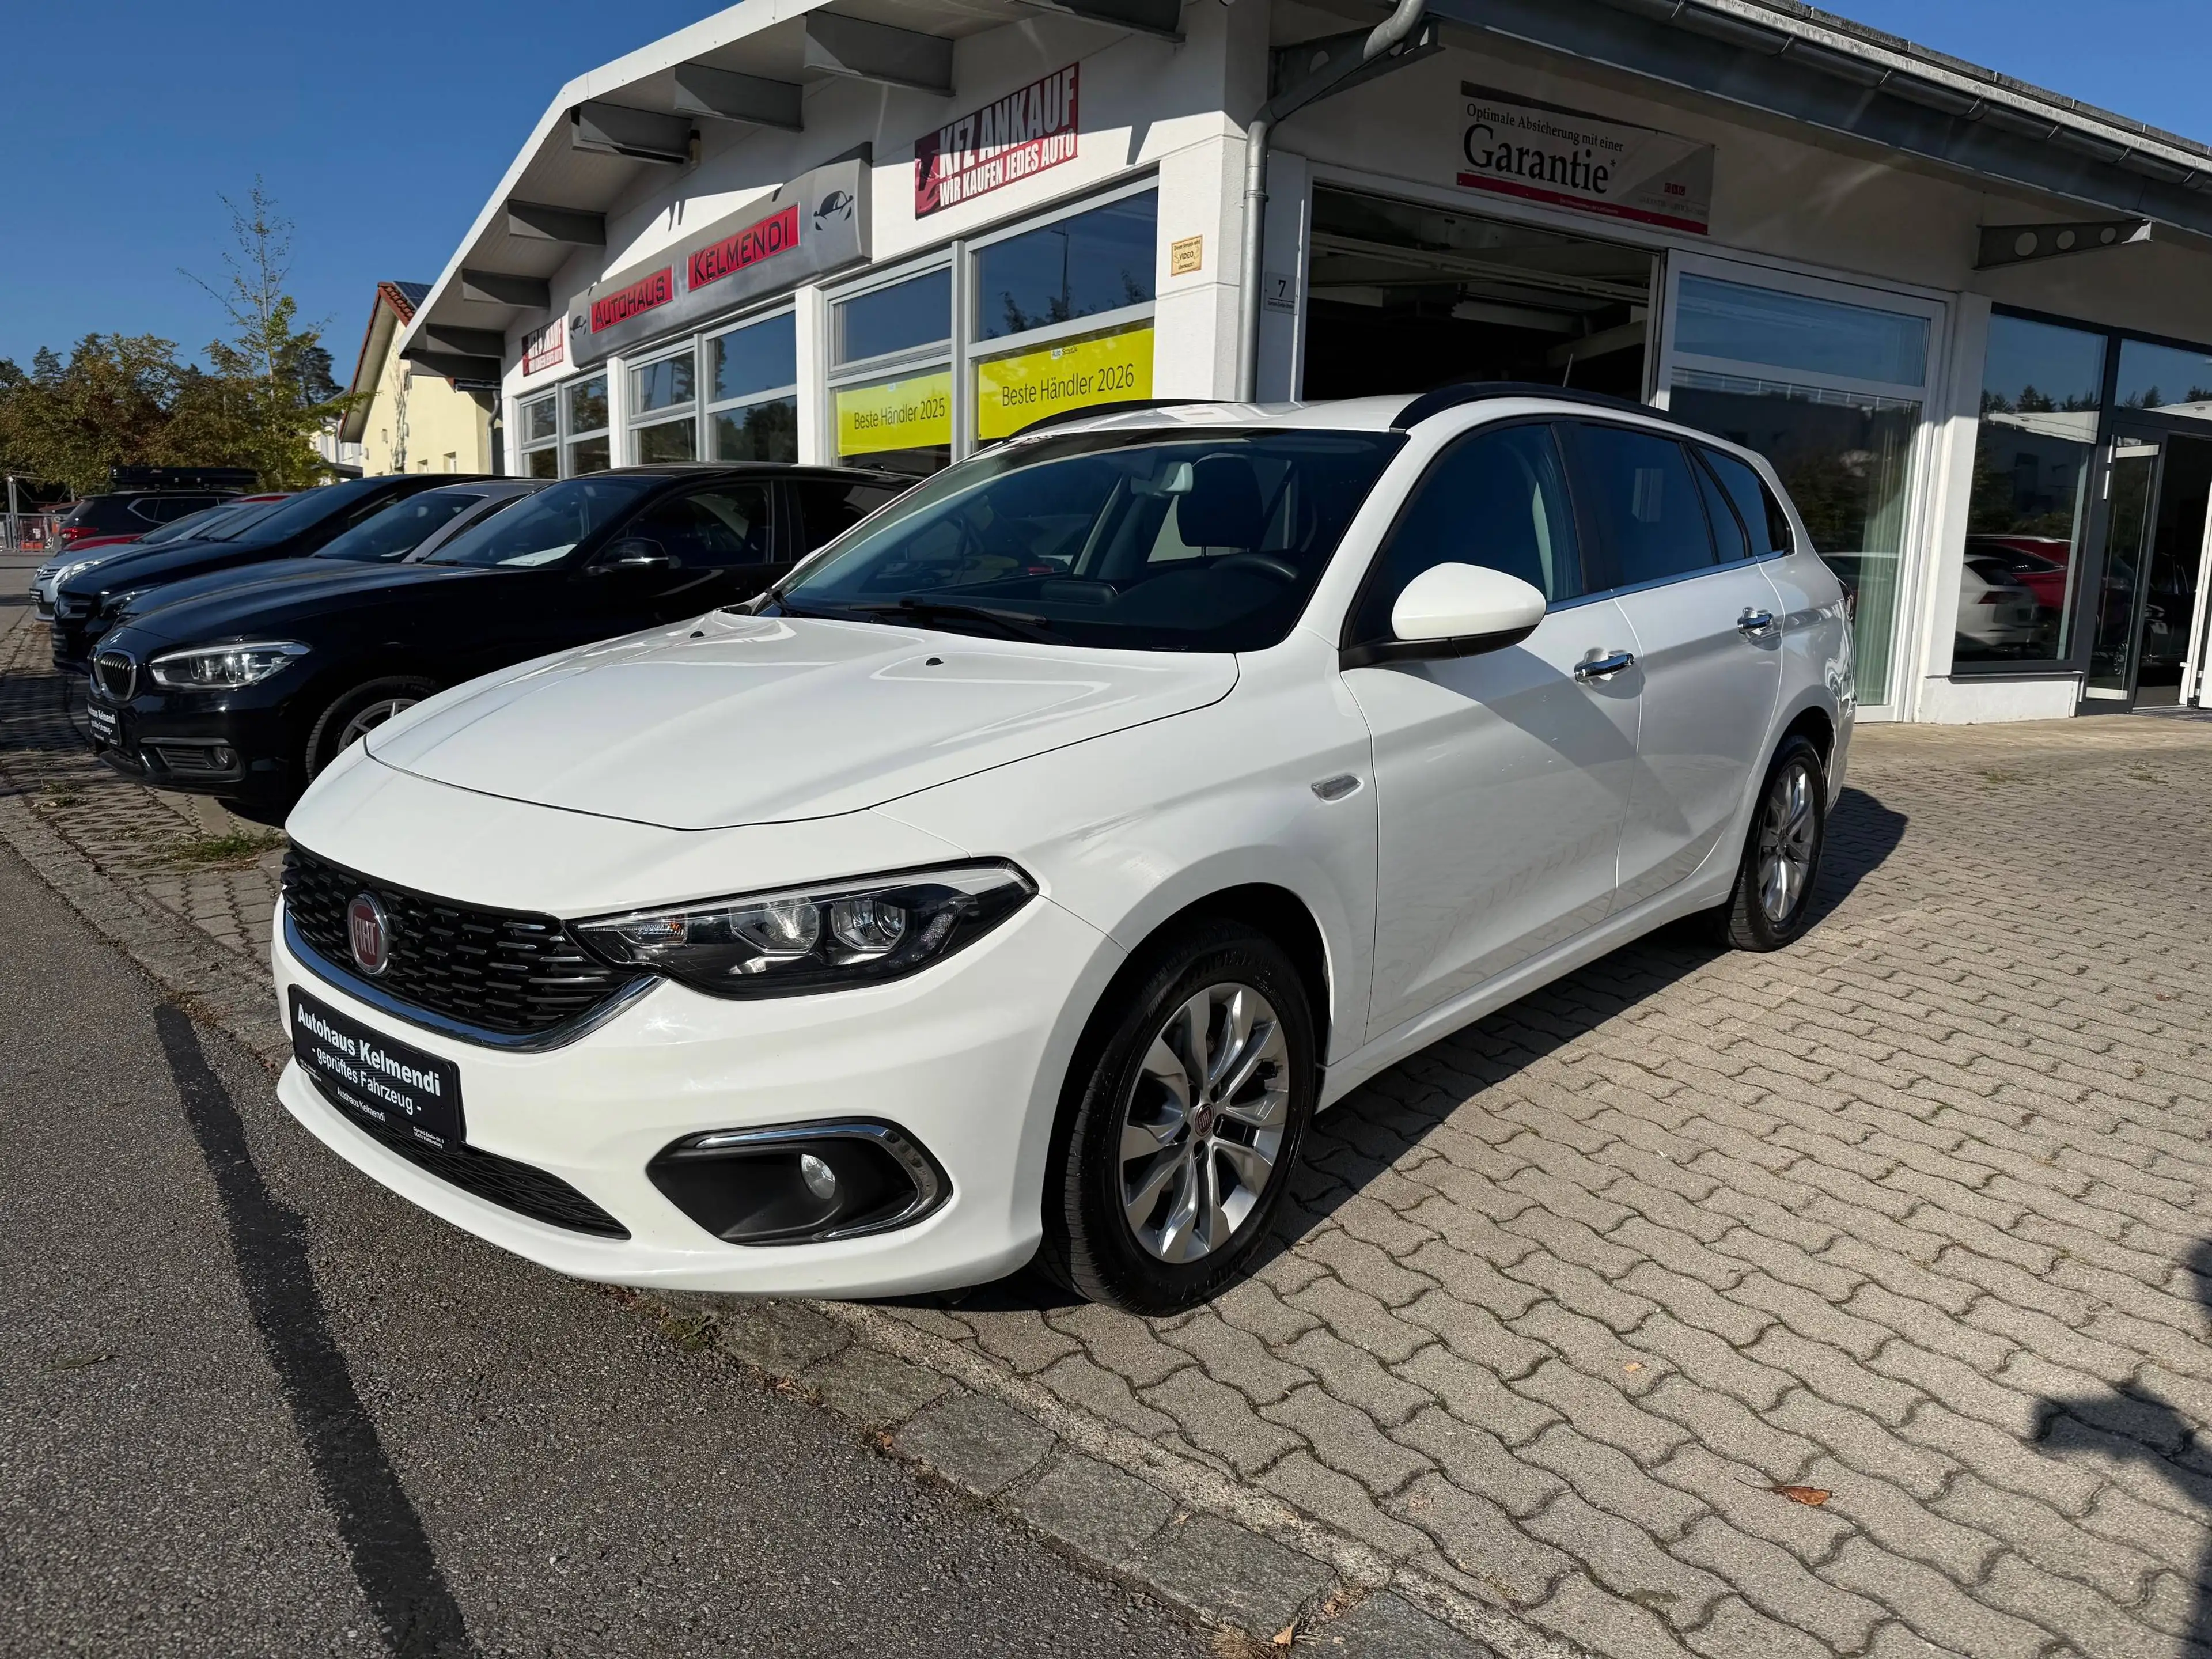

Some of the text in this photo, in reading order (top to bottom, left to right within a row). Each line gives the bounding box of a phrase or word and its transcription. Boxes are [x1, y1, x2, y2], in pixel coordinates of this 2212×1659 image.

[940, 66, 1074, 179] KFZ ANKAUF
[1467, 103, 1623, 152] Optimale Absicherung mit einer
[940, 128, 1074, 207] WIR KAUFEN JEDES AUTO
[596, 217, 788, 327] AUTOHAUS KELMENDI
[1179, 251, 1194, 260] VIDEO
[1278, 279, 1286, 297] 7
[1002, 363, 1135, 407] Beste Händler 2026
[854, 397, 945, 430] Beste Händler 2025
[354, 915, 376, 956] FIAT
[298, 1003, 356, 1056] Autohaus
[359, 1040, 440, 1096] Kelmendi
[316, 1047, 358, 1084] geprüftes
[360, 1070, 414, 1115] Fahrzeug
[337, 1087, 385, 1122] Autohaus Kelmendi
[1199, 1110, 1210, 1130] FIAT
